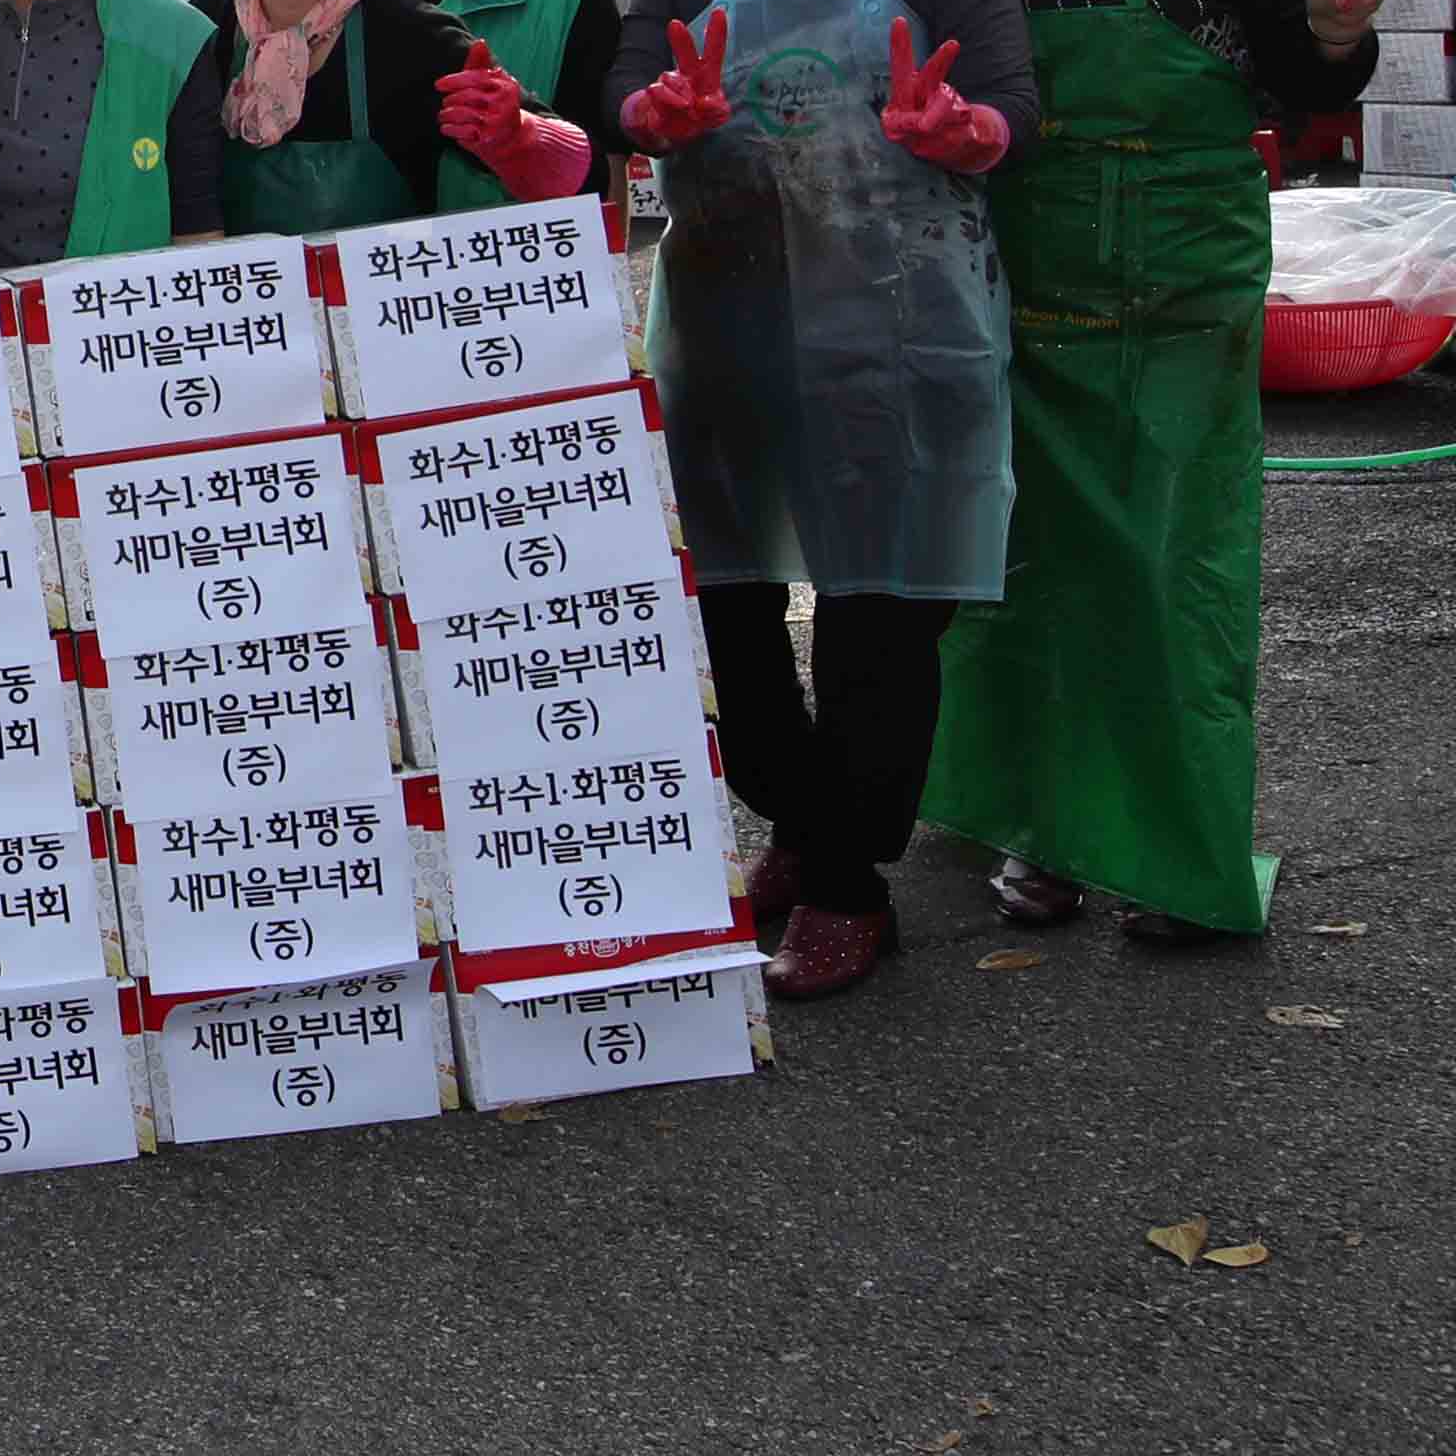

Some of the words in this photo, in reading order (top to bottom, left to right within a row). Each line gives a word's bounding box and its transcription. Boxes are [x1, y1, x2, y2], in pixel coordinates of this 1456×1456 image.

[376, 269, 590, 337] 새마을부녀회
[78, 310, 289, 375] 새마을부녀회
[459, 332, 524, 381] (증)
[159, 374, 223, 420] (증)
[419, 466, 633, 539] 새마을부녀회
[113, 510, 330, 576] 새마을부녀회
[452, 632, 667, 699] 새마을부녀회
[139, 680, 357, 742] 새마을부녀회
[474, 810, 693, 871] 새마을부녀회
[166, 855, 385, 914] 새마을부녀회
[190, 1001, 405, 1062] 새마을부녀회
[582, 1020, 648, 1068] (증)
[271, 1062, 337, 1109] (증)
